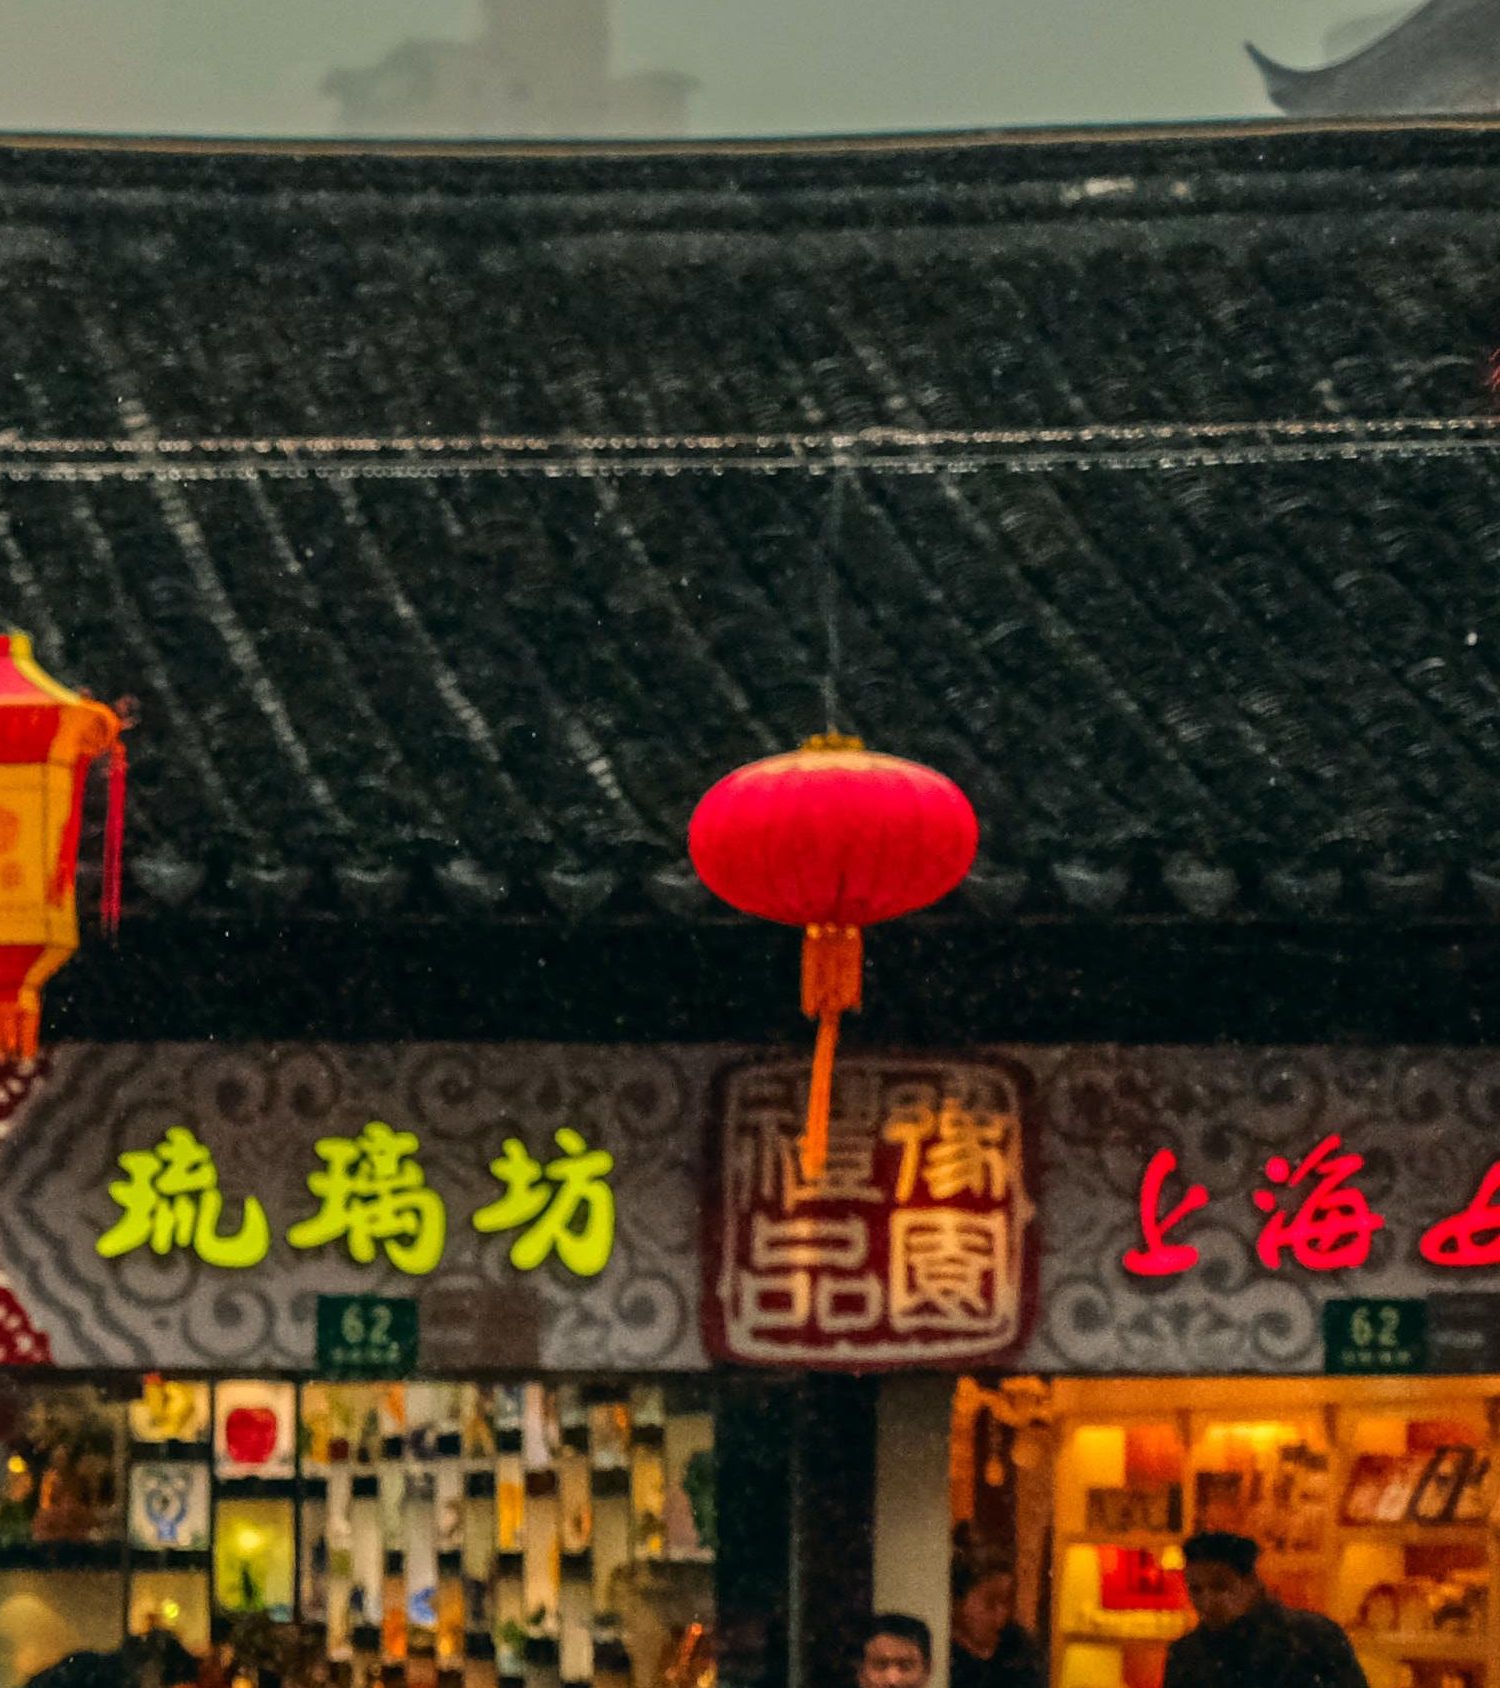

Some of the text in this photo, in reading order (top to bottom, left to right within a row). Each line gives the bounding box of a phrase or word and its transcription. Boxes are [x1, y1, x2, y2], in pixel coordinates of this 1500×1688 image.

[96, 1123, 614, 1275] 琉璃坊
[341, 1304, 391, 1344] 62
[1351, 1306, 1399, 1346] 62
